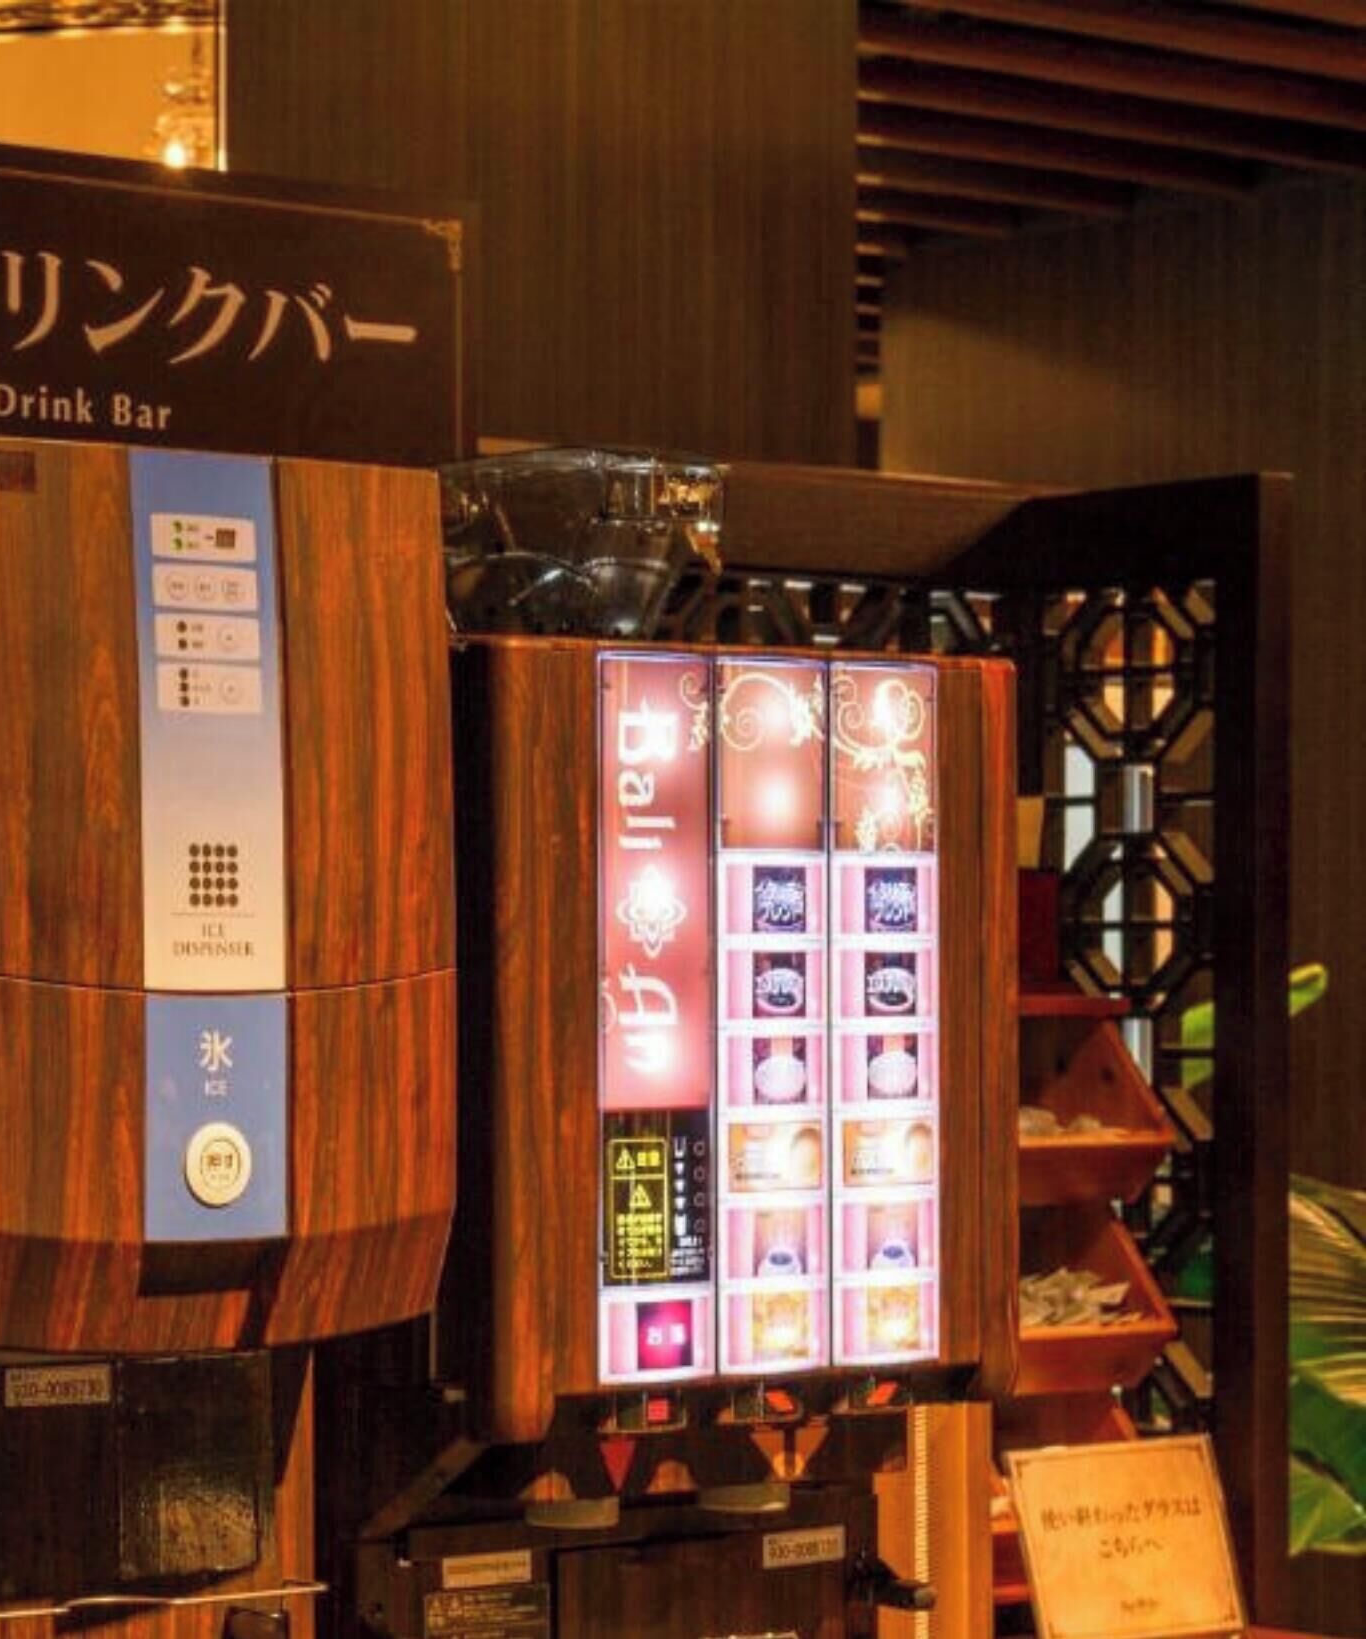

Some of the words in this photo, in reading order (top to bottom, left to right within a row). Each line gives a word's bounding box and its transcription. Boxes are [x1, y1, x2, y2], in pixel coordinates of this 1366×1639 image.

[111, 392, 172, 430] Bar
[618, 699, 678, 850] Bali
[173, 939, 254, 957] DISPENSER
[202, 922, 225, 938] ICE
[199, 1030, 234, 1072] 氷
